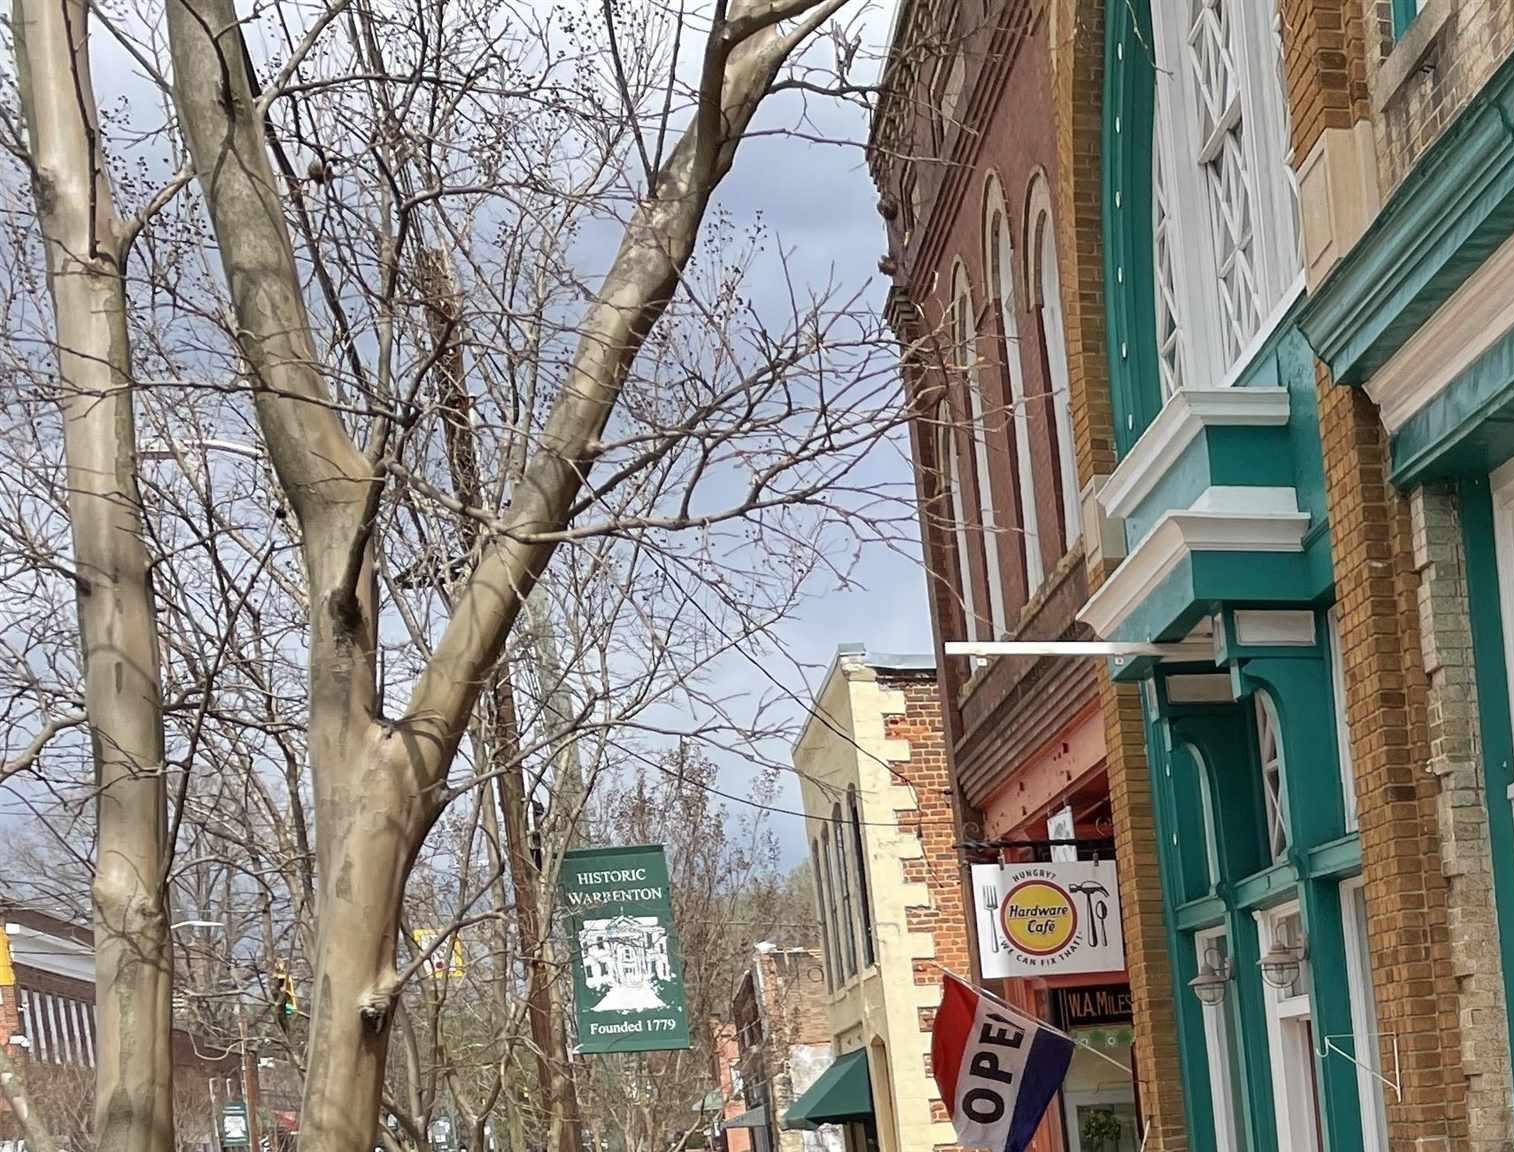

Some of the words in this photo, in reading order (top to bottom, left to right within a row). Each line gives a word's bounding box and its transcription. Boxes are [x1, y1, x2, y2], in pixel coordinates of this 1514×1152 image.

[576, 868, 647, 885] HISTORIC
[1012, 868, 1057, 882] HUNGRY?
[568, 887, 663, 906] WARRENTON
[1009, 905, 1069, 918] Hardware
[1027, 919, 1056, 935] Café
[1016, 954, 1036, 965] CAN
[1040, 957, 1057, 966] FIX
[590, 1020, 643, 1035] Founded
[647, 1018, 677, 1033] 1779
